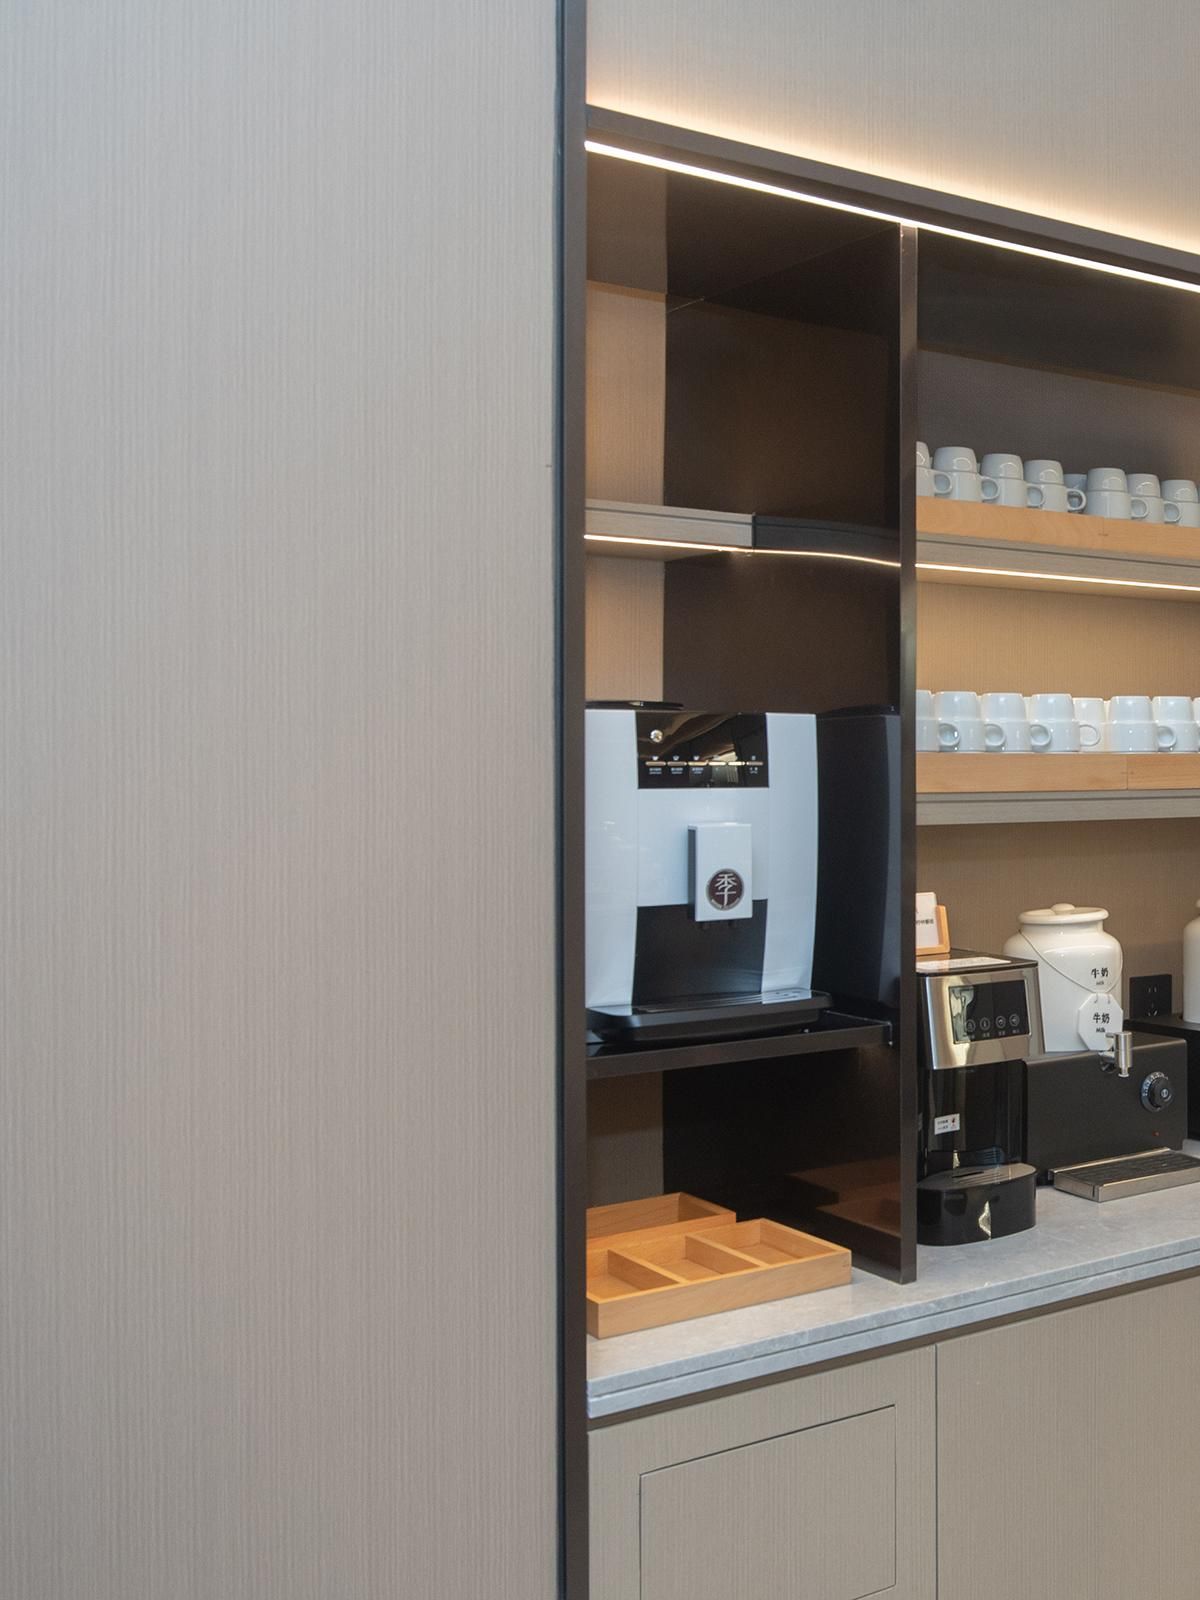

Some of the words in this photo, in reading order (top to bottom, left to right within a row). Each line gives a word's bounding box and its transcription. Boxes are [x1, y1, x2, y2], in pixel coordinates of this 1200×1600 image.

[714, 873, 737, 906] 季
[1091, 967, 1109, 979] 牛奶
[1092, 1012, 1110, 1024] 牛奶
